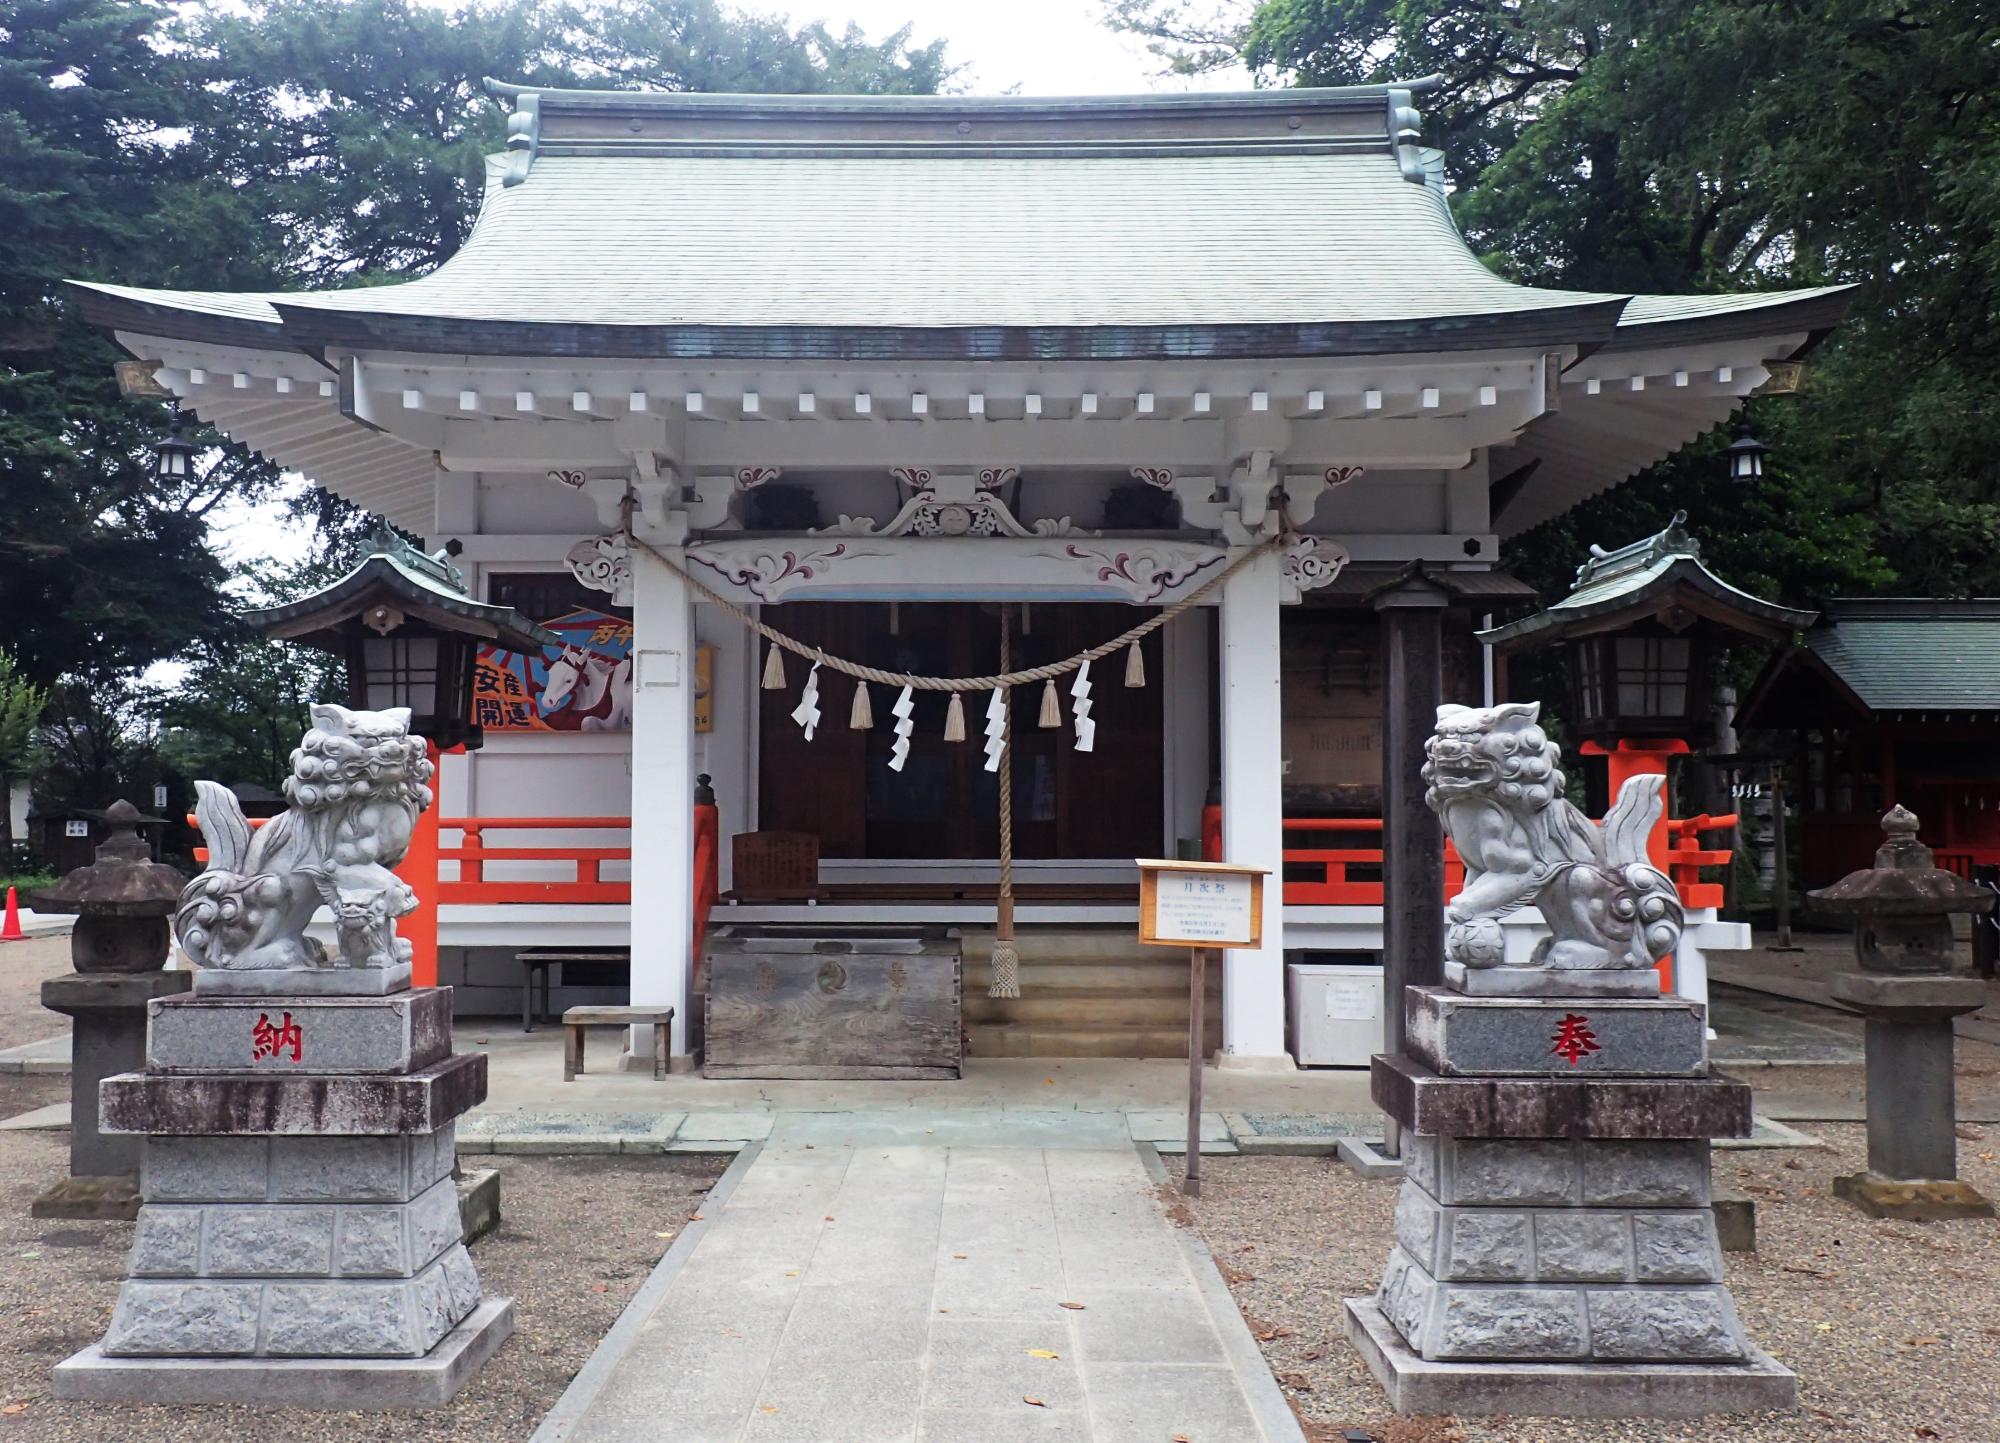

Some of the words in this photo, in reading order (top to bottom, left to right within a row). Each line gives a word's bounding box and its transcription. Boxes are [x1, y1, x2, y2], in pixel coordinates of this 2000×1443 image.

[475, 663, 523, 697] 安産
[477, 698, 531, 727] 開運
[1184, 882, 1226, 894] 月次祭
[252, 1011, 303, 1063] 納
[1551, 1013, 1601, 1067] 奉
